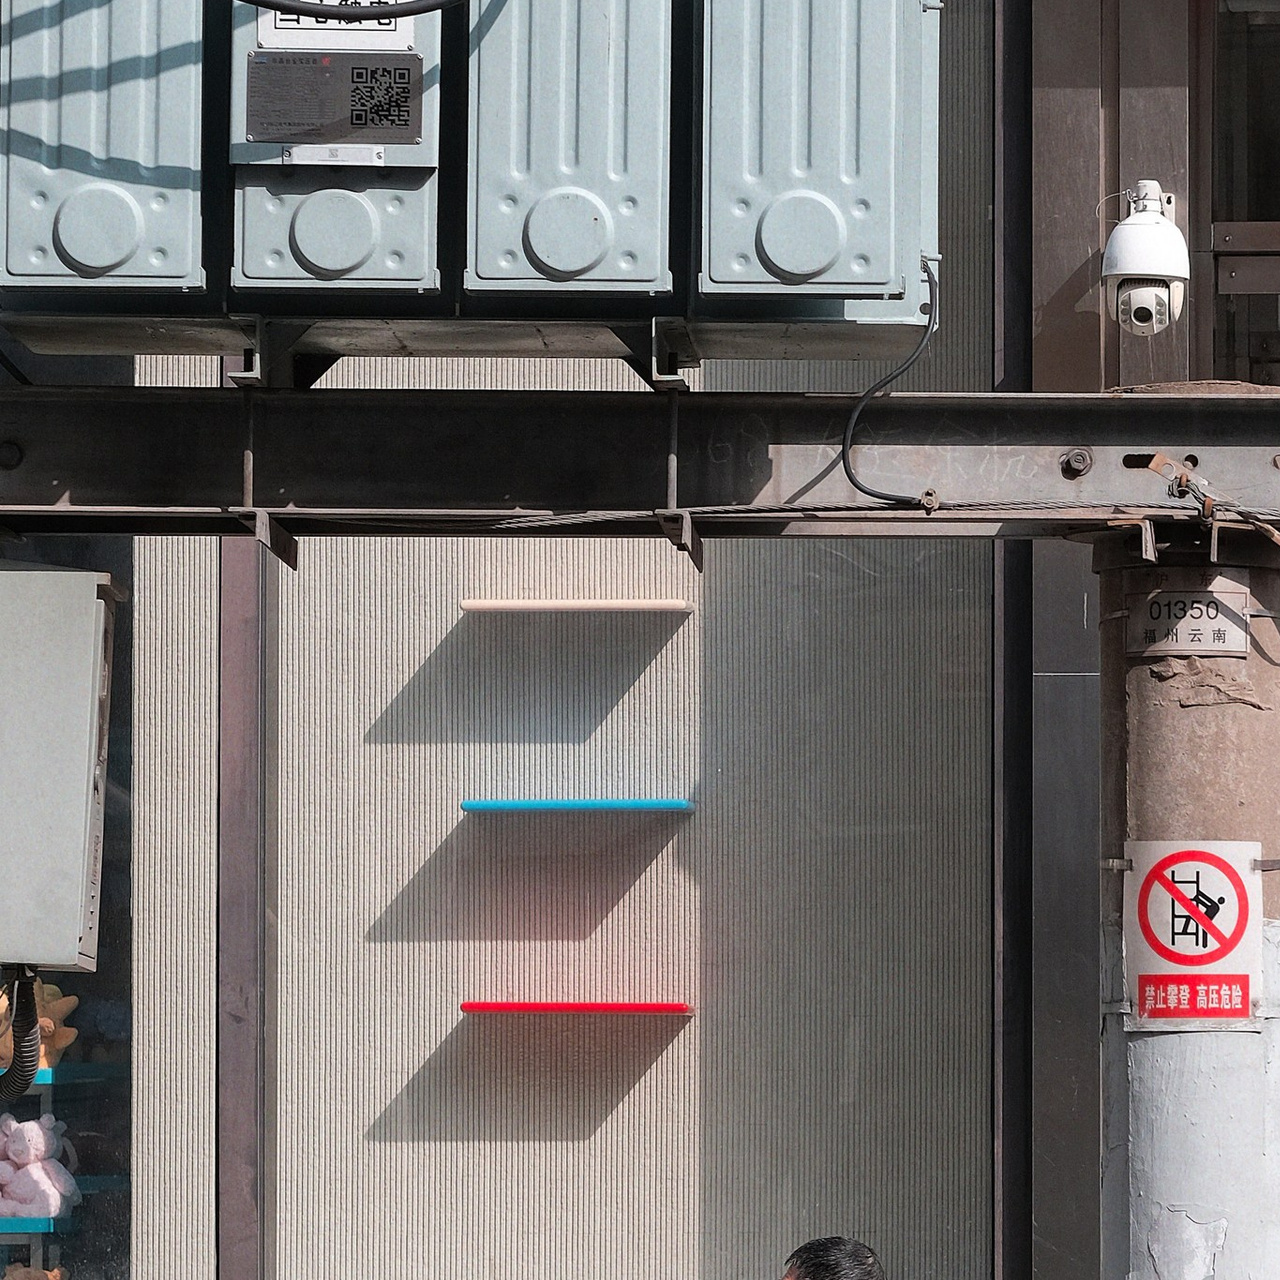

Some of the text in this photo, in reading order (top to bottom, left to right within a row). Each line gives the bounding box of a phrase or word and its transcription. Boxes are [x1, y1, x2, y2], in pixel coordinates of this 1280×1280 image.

[1149, 600, 1219, 620] 01350
[1143, 627, 1227, 644] 福州云南
[1144, 984, 1242, 1010] 禁止攀登 高压危险
